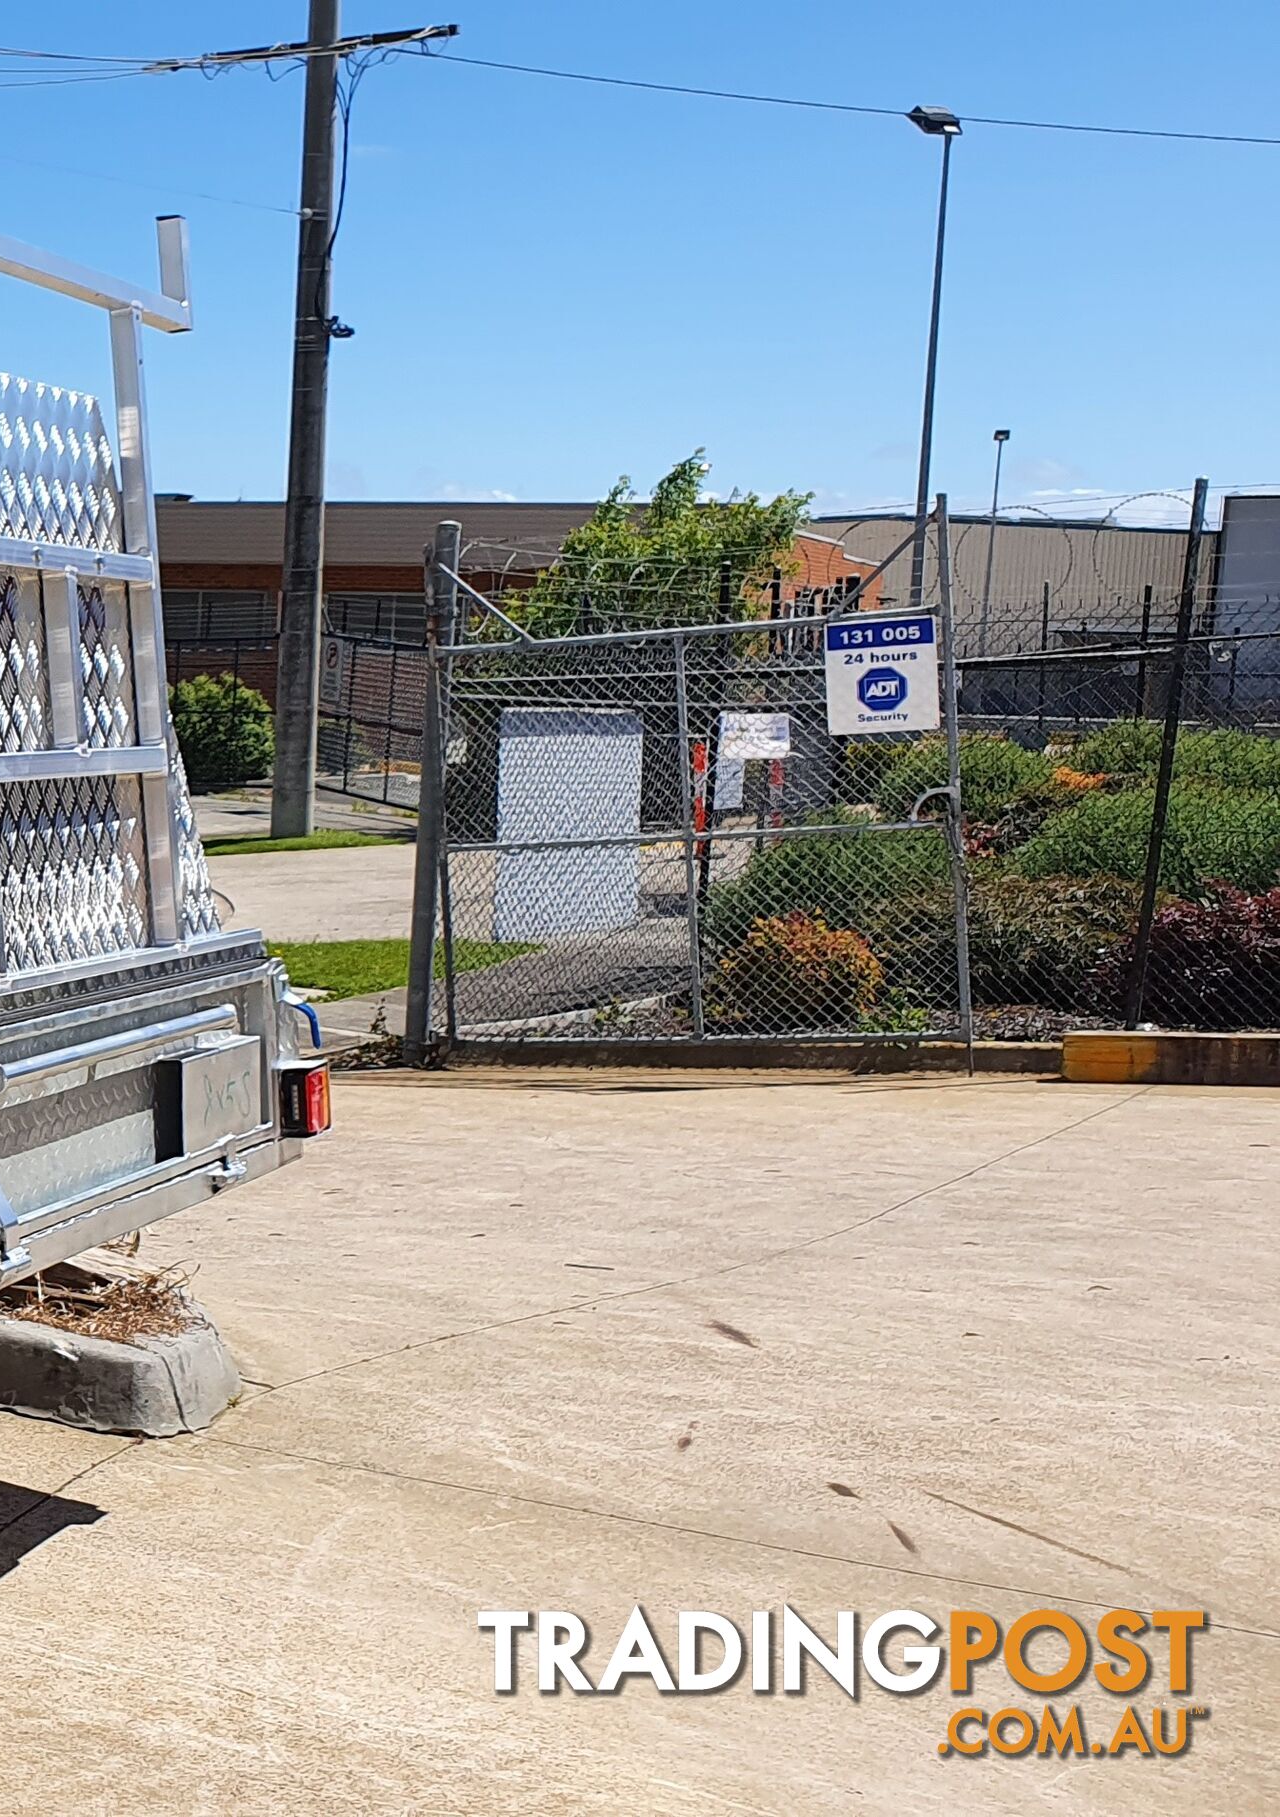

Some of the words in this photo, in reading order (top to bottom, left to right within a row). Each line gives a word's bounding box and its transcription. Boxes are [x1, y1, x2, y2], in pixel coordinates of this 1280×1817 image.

[840, 629, 874, 645] 131
[881, 625, 921, 642] 005
[844, 653, 865, 665] 24
[870, 651, 918, 663] hours
[866, 680, 900, 698] ADT
[857, 712, 908, 723] Security
